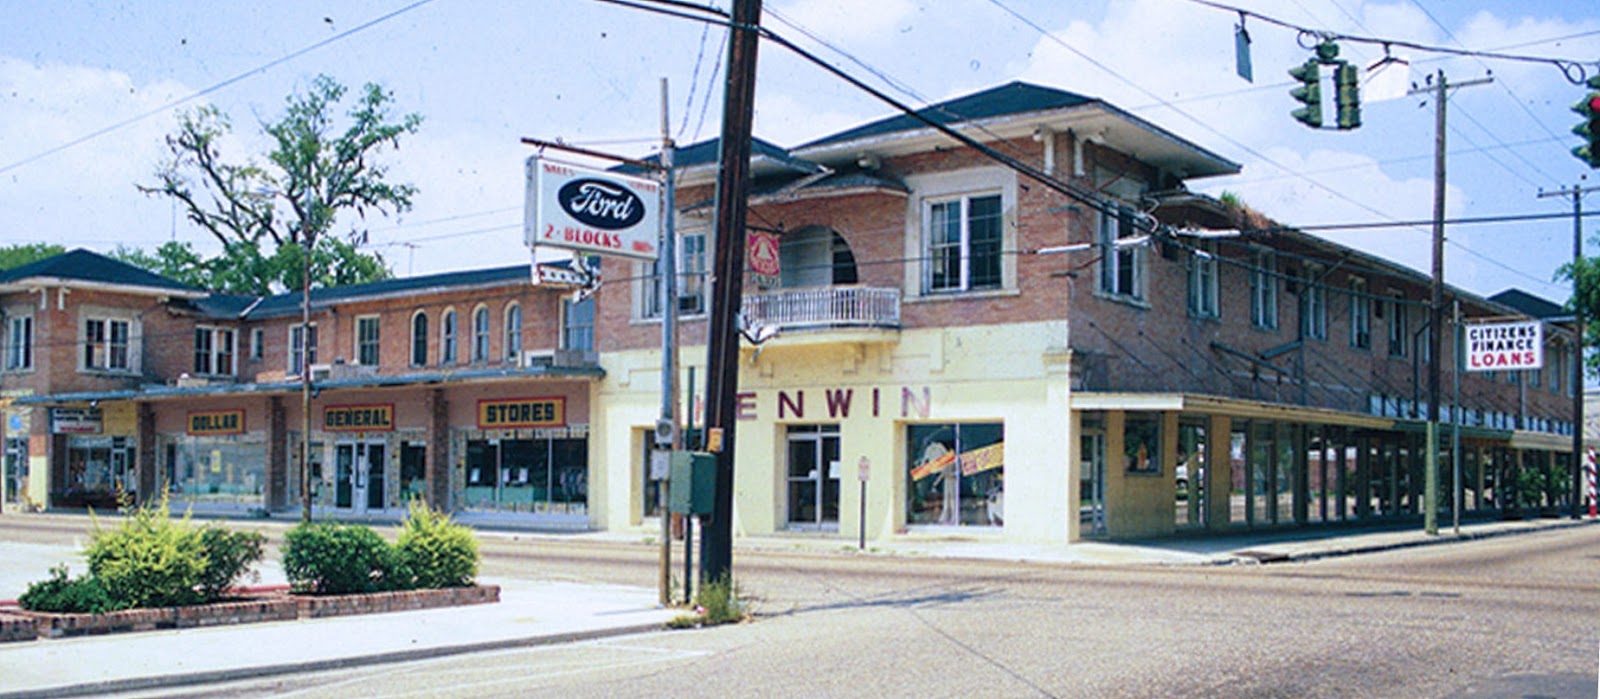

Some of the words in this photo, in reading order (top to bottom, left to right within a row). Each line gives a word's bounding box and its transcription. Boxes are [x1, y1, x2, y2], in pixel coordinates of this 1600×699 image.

[570, 182, 635, 220] Ford
[1470, 326, 1536, 340] CITIZENS
[1472, 339, 1534, 352] FINANCE
[1471, 351, 1535, 368] LOANS
[326, 408, 390, 427] GENERAL
[487, 402, 555, 423] STORES
[192, 414, 238, 431] DOLLAR
